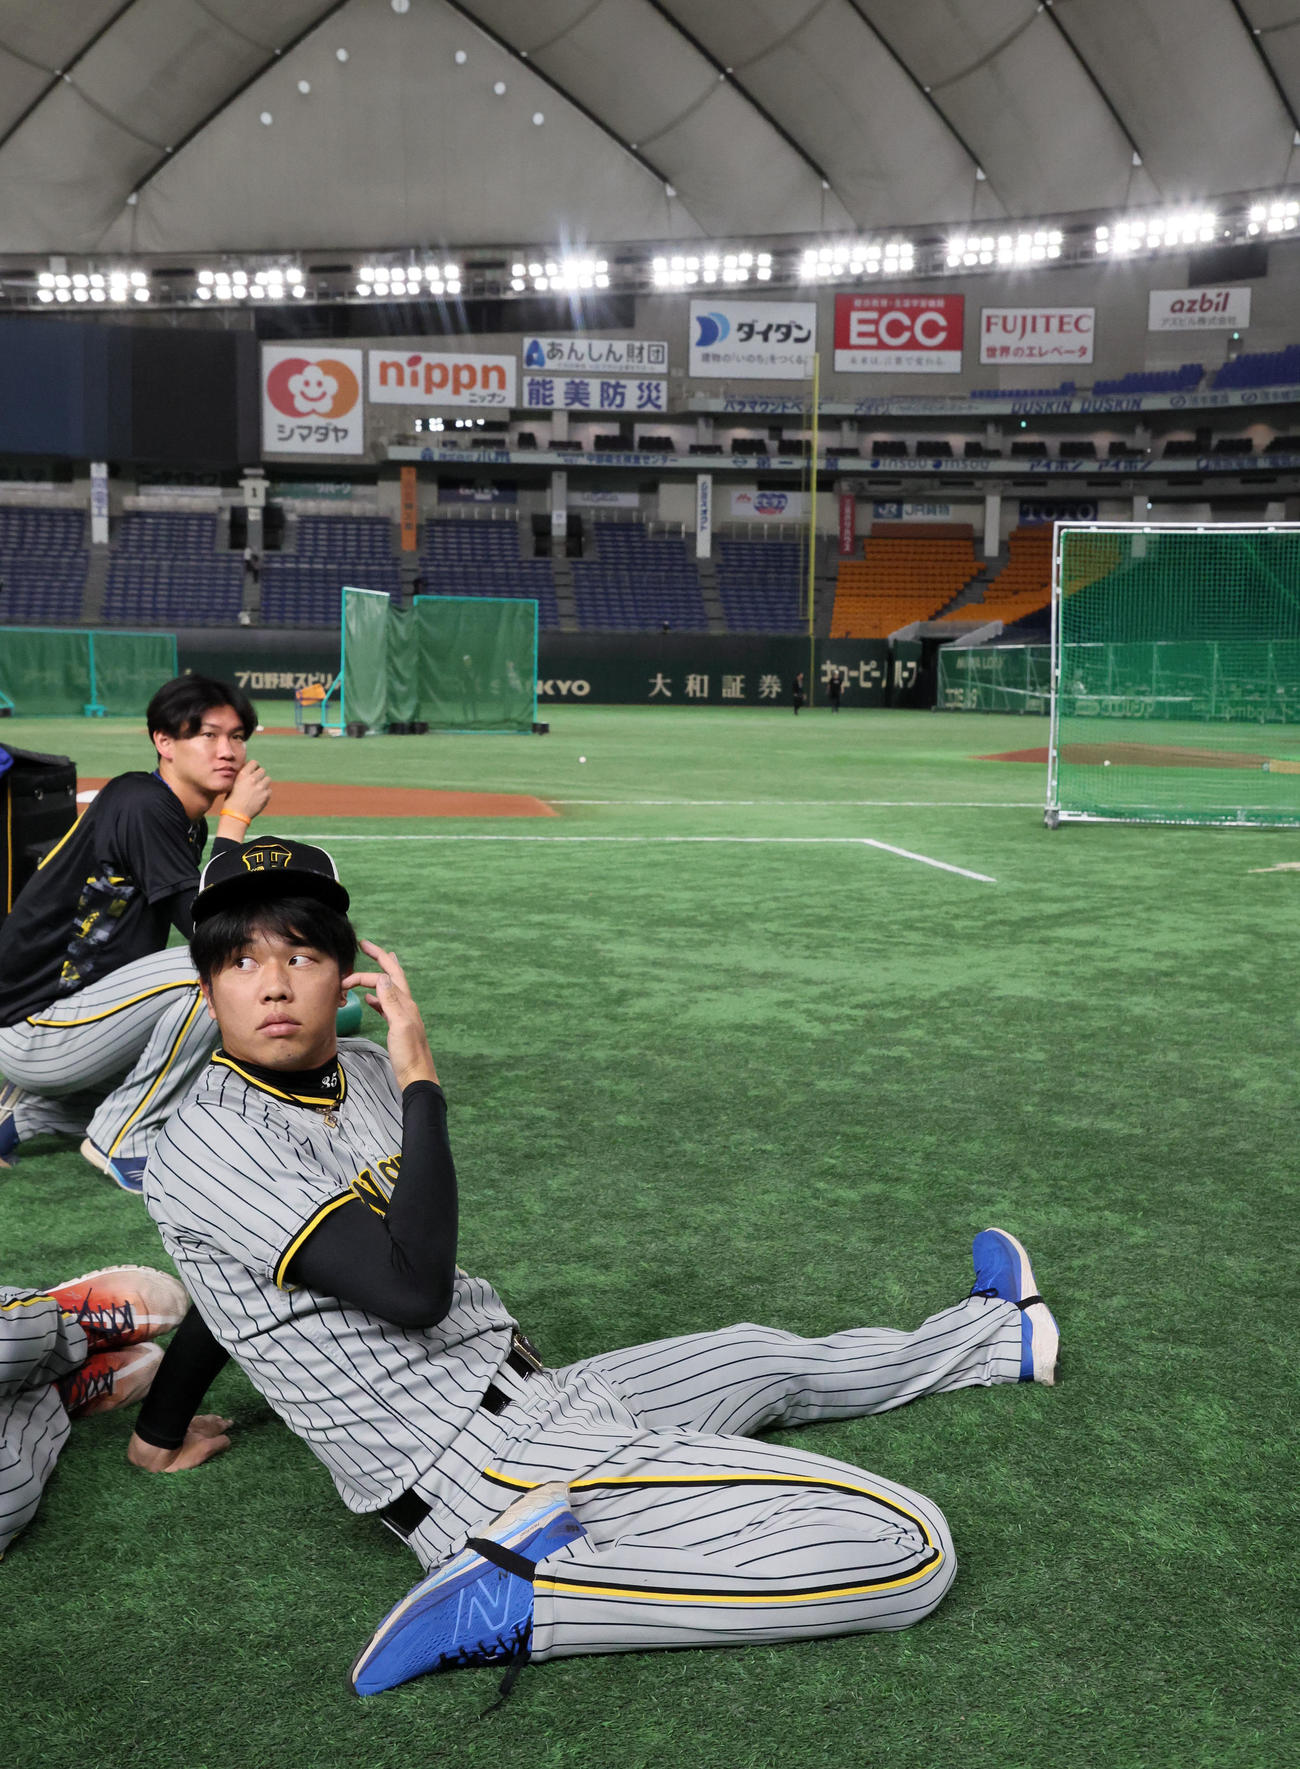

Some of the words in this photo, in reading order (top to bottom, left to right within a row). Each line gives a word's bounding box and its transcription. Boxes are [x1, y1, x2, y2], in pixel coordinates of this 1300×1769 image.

[1170, 291, 1230, 313] azbil
[737, 320, 811, 343] ダイダン
[850, 311, 947, 347] ECC
[985, 314, 1091, 339] FUJITEC
[547, 342, 665, 364] あんしん財団
[986, 345, 1087, 359] 世界のエレベータ
[379, 355, 506, 395] nippn
[469, 393, 506, 404] ニップン
[528, 378, 662, 410] 能美防災
[724, 400, 822, 414] パラマウントベ
[1012, 400, 1071, 414] DUSKIN
[1080, 398, 1143, 413] DUSKIN
[277, 422, 348, 443] シマダヤ
[1022, 504, 1095, 522] TOTO
[234, 670, 340, 690] プロ野球スピリ
[648, 673, 782, 699] 大和証券
